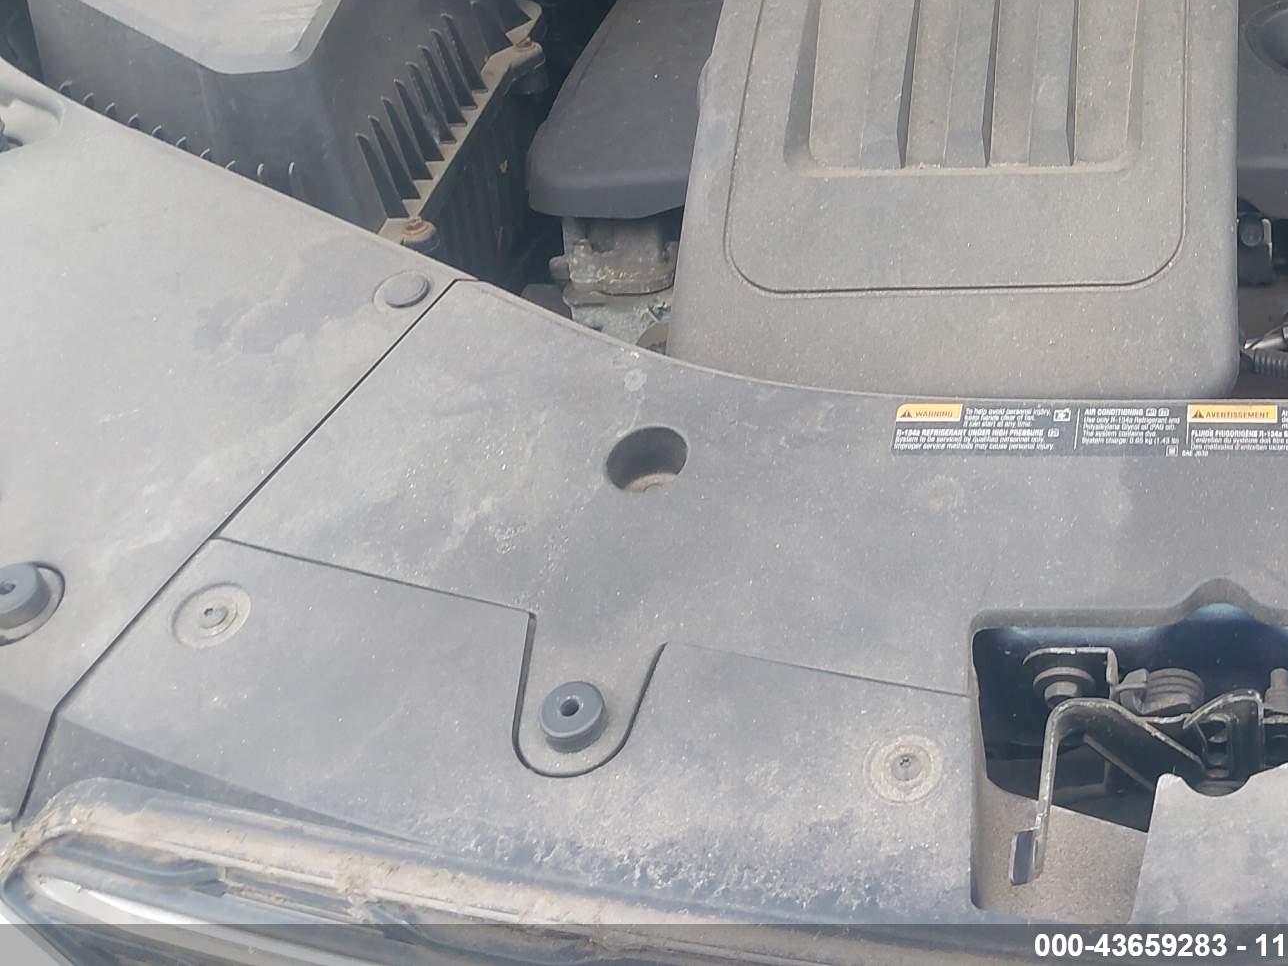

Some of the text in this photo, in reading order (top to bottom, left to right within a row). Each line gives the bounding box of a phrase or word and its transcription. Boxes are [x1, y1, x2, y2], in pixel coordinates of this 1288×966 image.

[914, 410, 953, 418] WARNING
[1084, 408, 1144, 416] AIR CONDITIONING
[1206, 411, 1269, 419] AVERTISSEMENT
